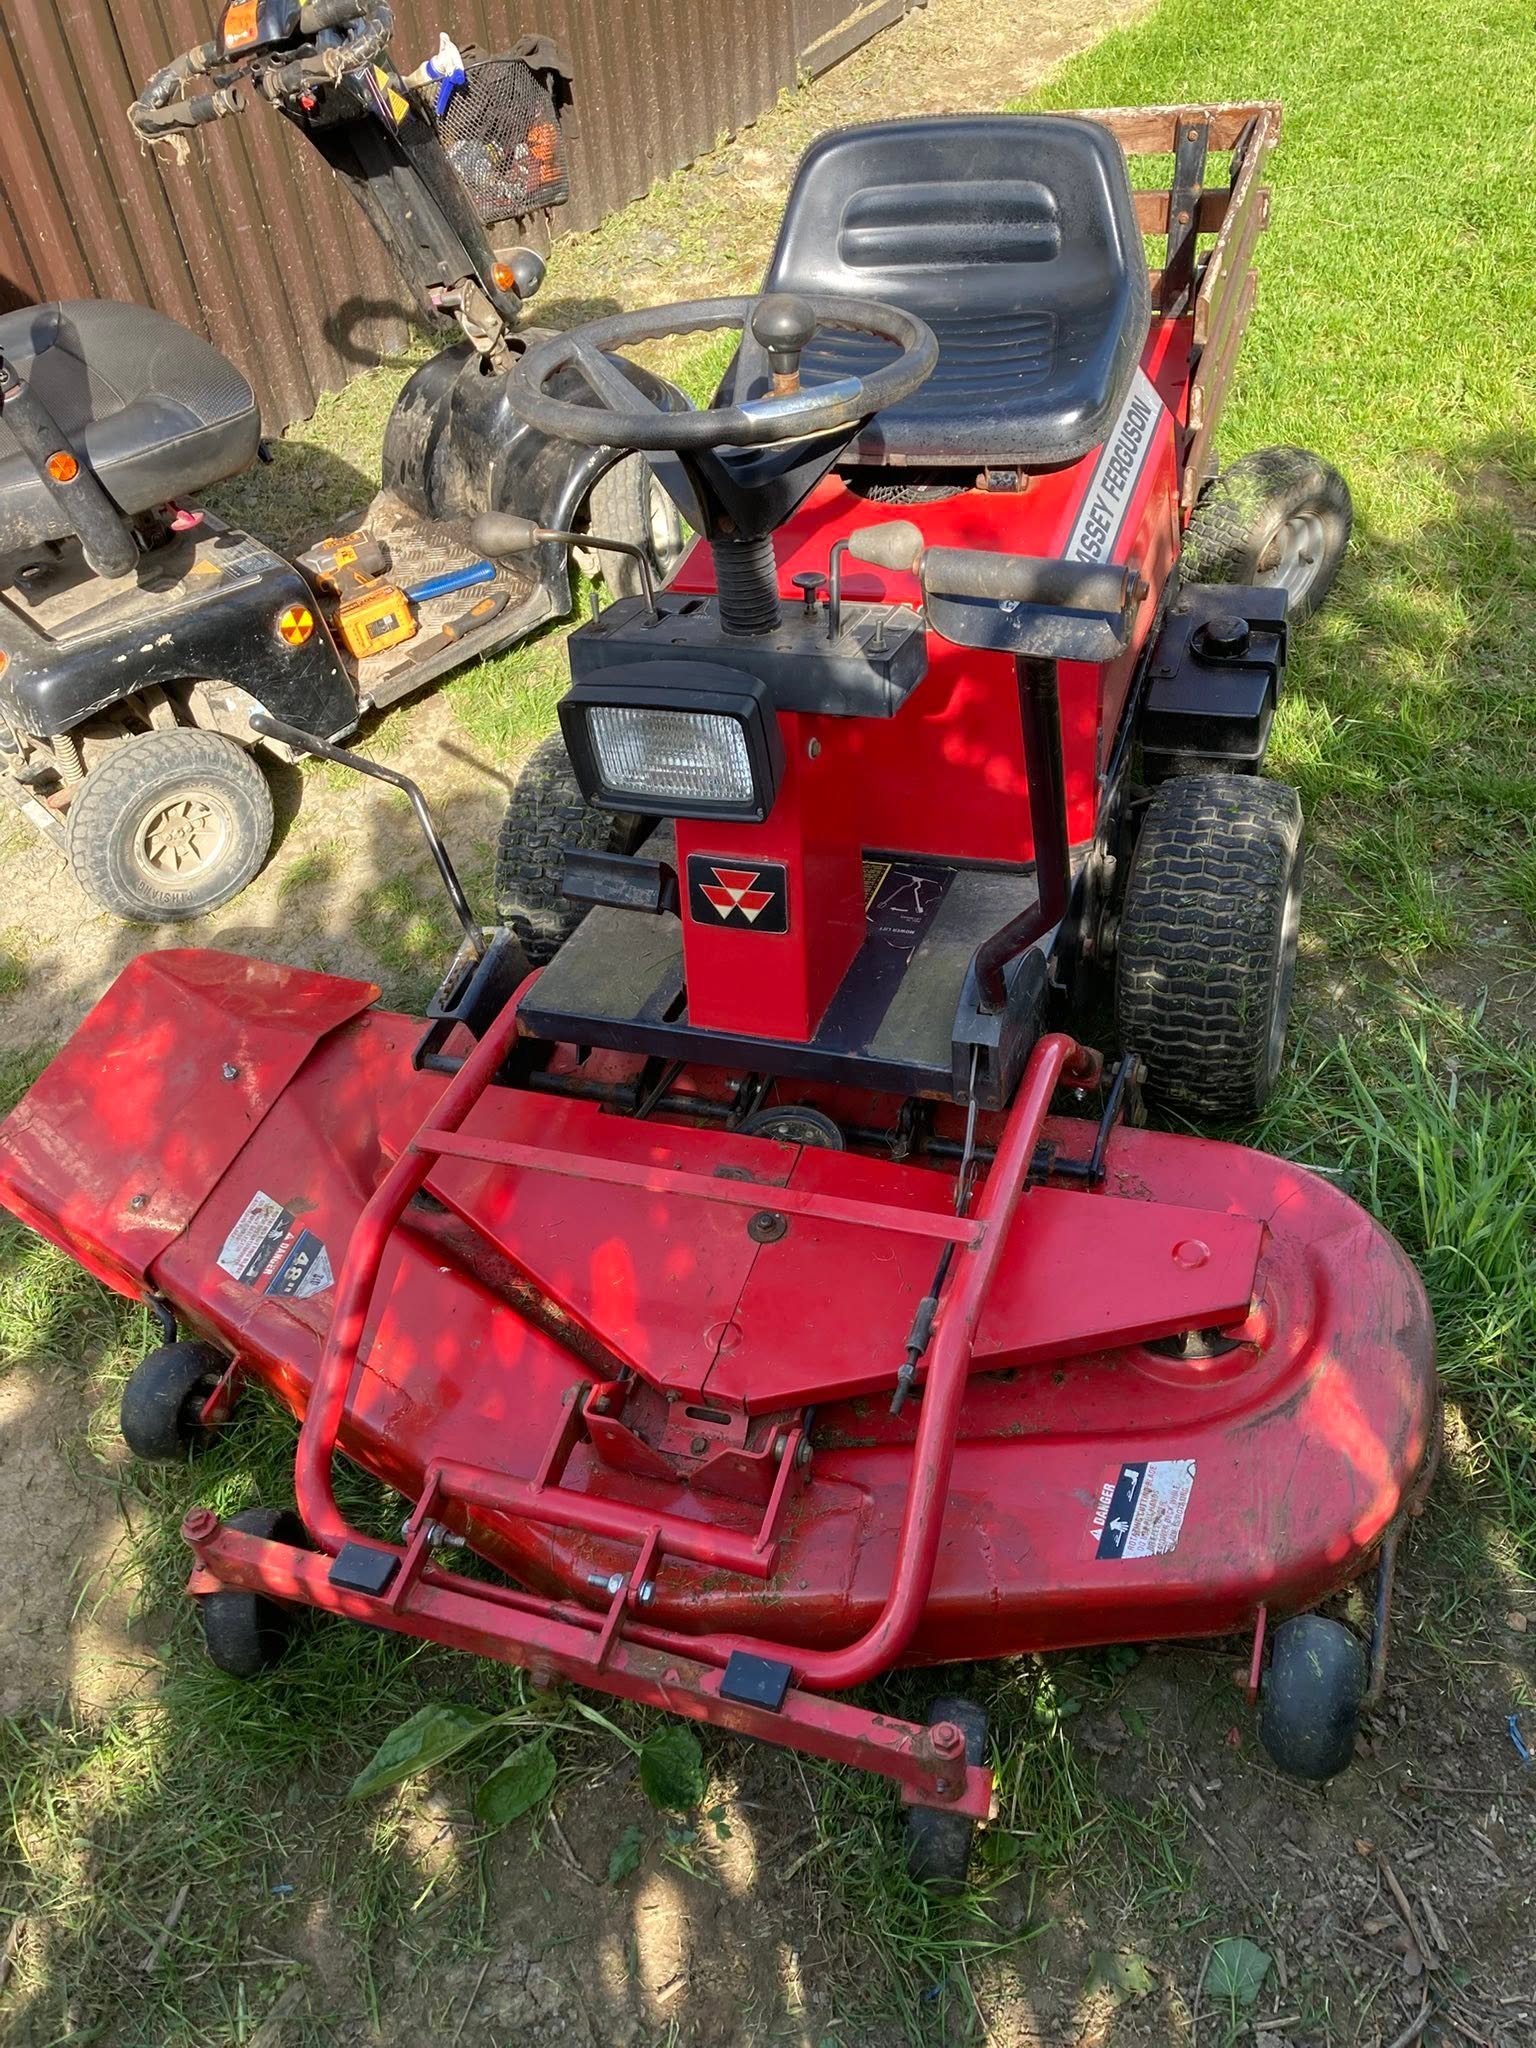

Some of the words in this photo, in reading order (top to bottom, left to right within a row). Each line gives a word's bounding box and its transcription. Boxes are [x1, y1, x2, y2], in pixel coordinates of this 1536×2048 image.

[1075, 494, 1115, 563] ASSEY
[1101, 395, 1151, 502] FERGUSON
[263, 1242, 290, 1275] DANGER
[1093, 1483, 1116, 1526] DANGER
[1127, 1516, 1144, 1551] ROTATING
[1137, 1487, 1151, 1516] CUTTING
[1145, 1465, 1157, 1487] BLADE
